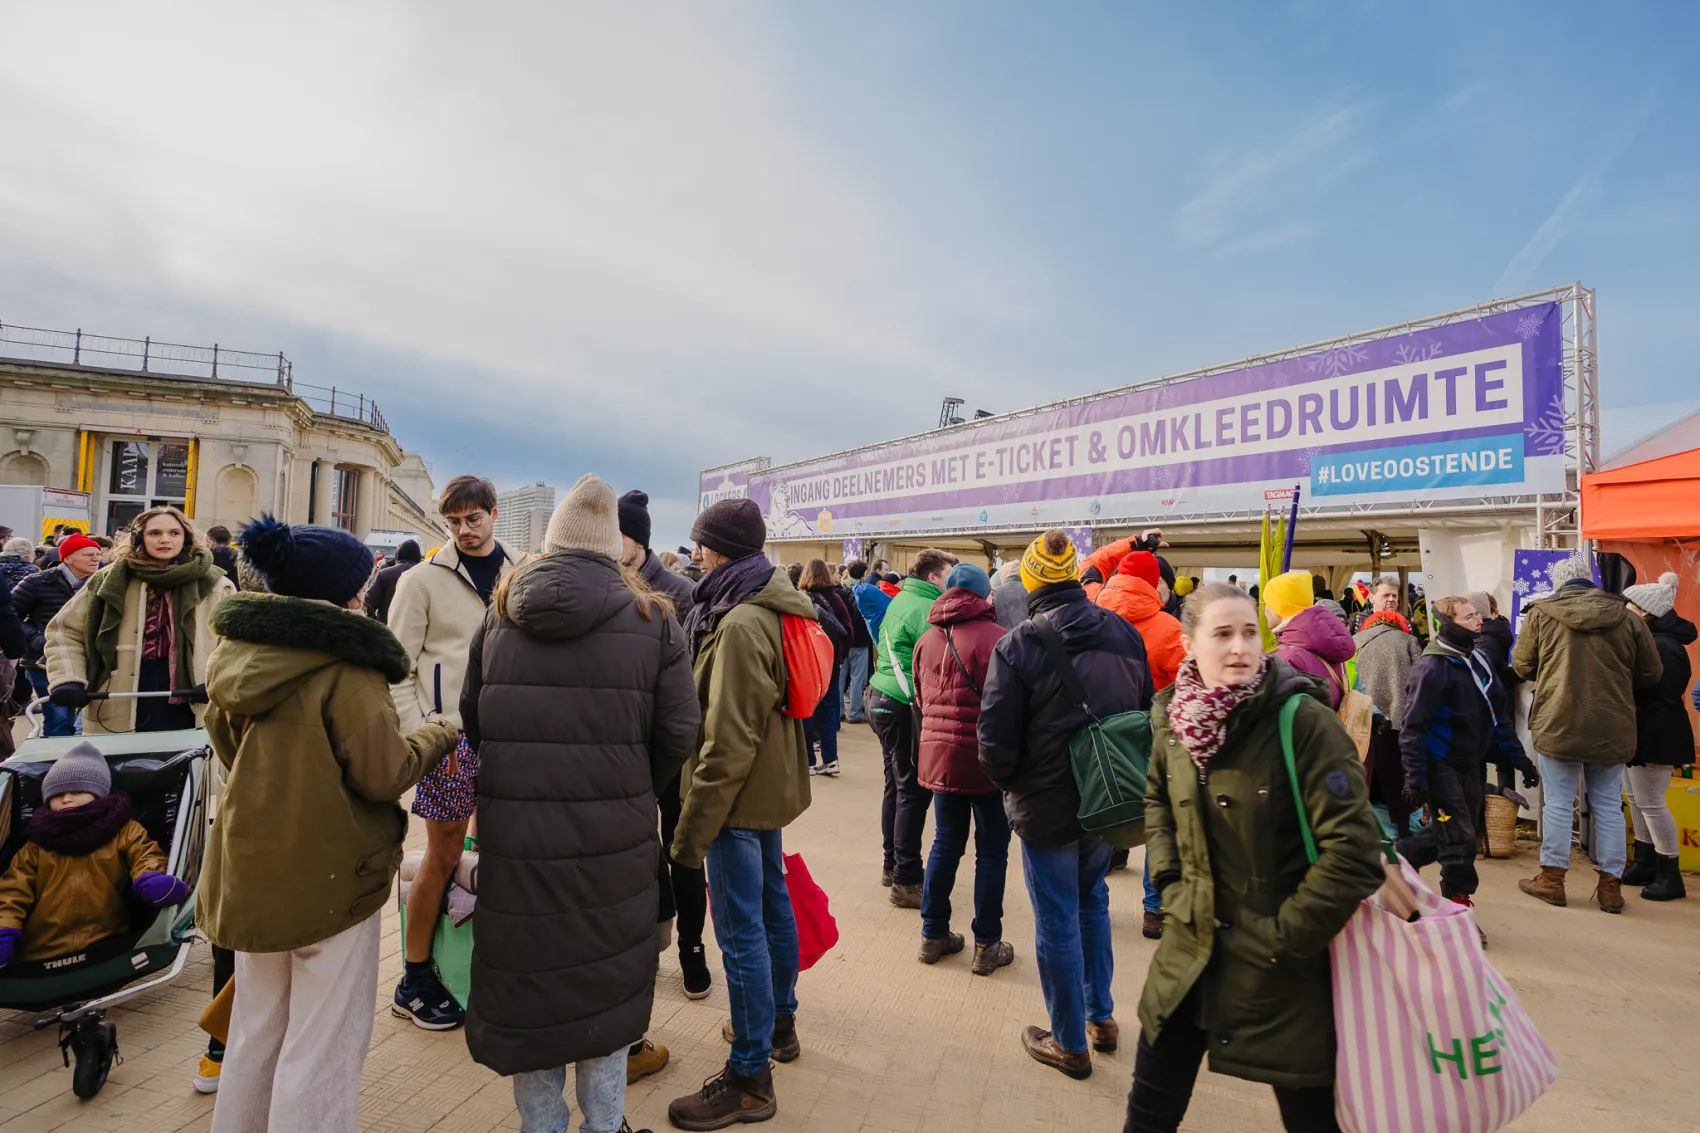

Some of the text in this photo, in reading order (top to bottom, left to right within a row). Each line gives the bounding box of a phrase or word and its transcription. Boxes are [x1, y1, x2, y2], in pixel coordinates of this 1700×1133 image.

[790, 359, 1508, 503] INGANG DEELNEMERS MET E-TICKET & OMKLEEDRUIMTE
[1318, 448, 1513, 484] #LOVEOOSTENDE
[43, 953, 87, 970] THULE
